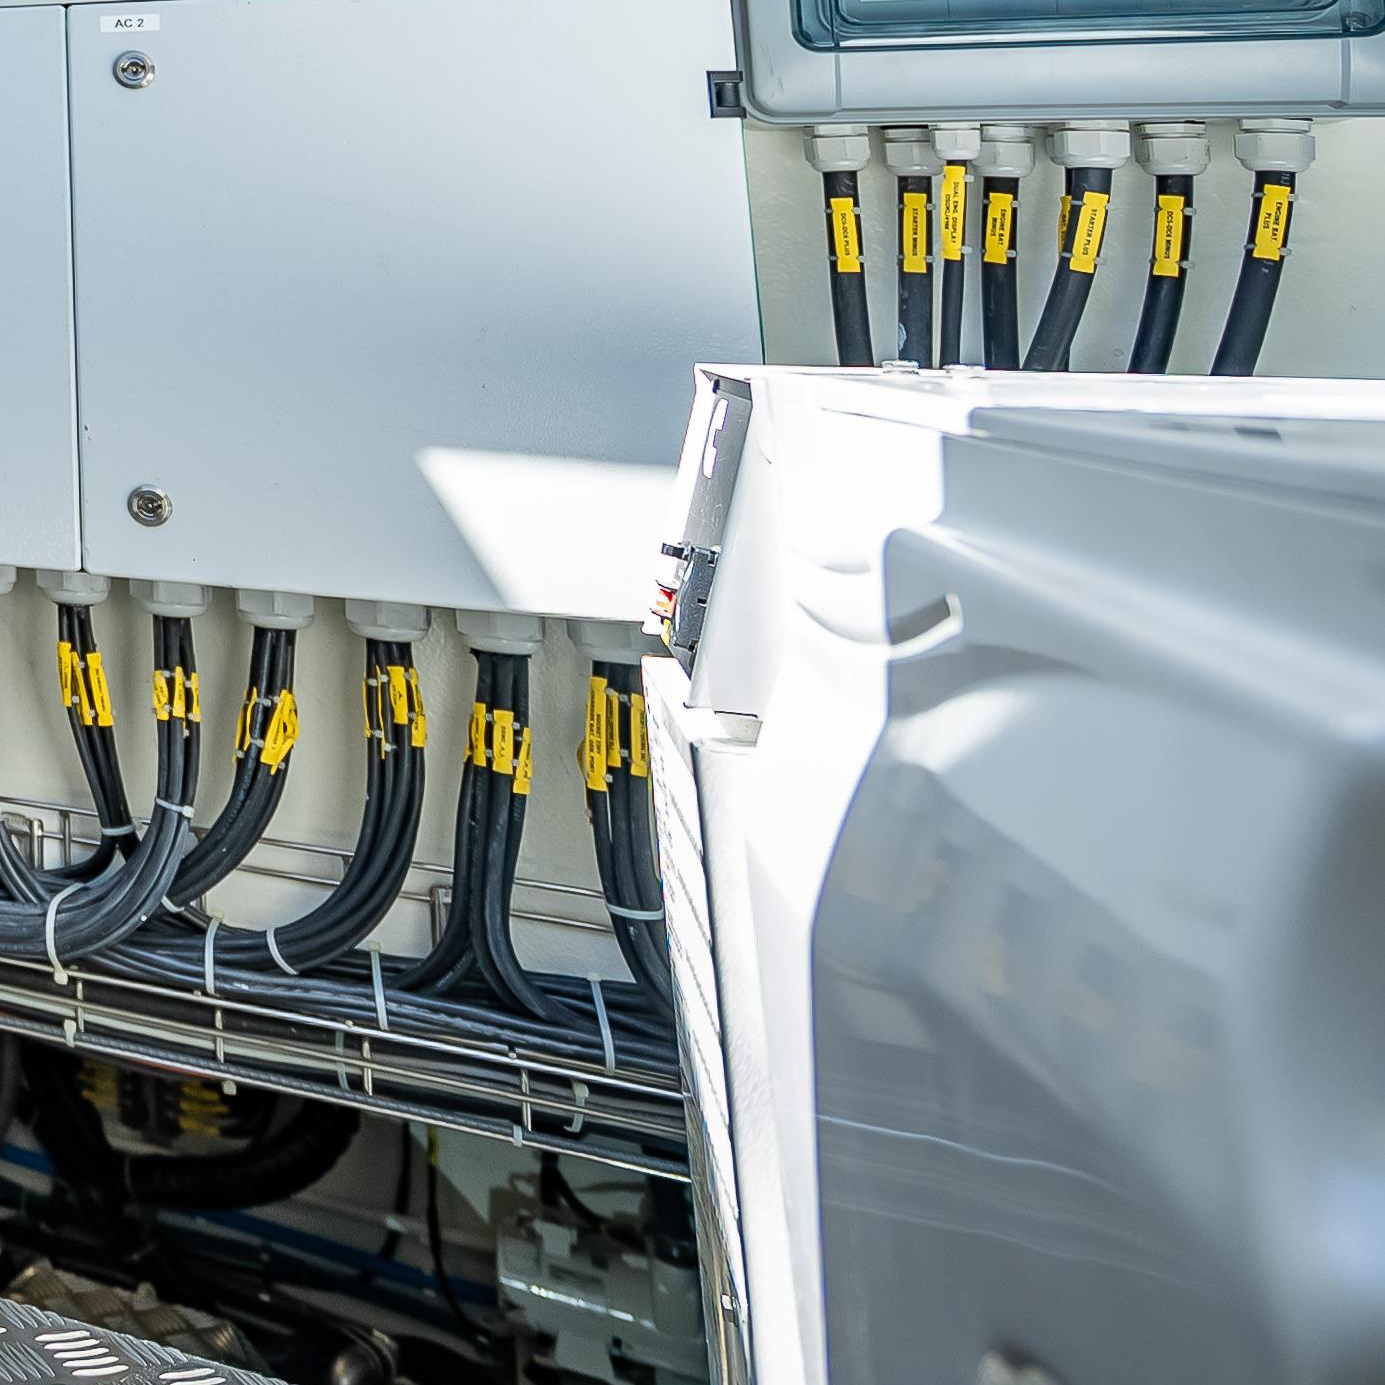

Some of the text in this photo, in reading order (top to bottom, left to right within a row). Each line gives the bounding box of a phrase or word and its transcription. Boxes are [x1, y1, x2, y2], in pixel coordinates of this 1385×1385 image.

[114, 18, 144, 28] AC 2
[1263, 212, 1272, 229] PLUS
[1082, 208, 1098, 256] STARTER PLUS
